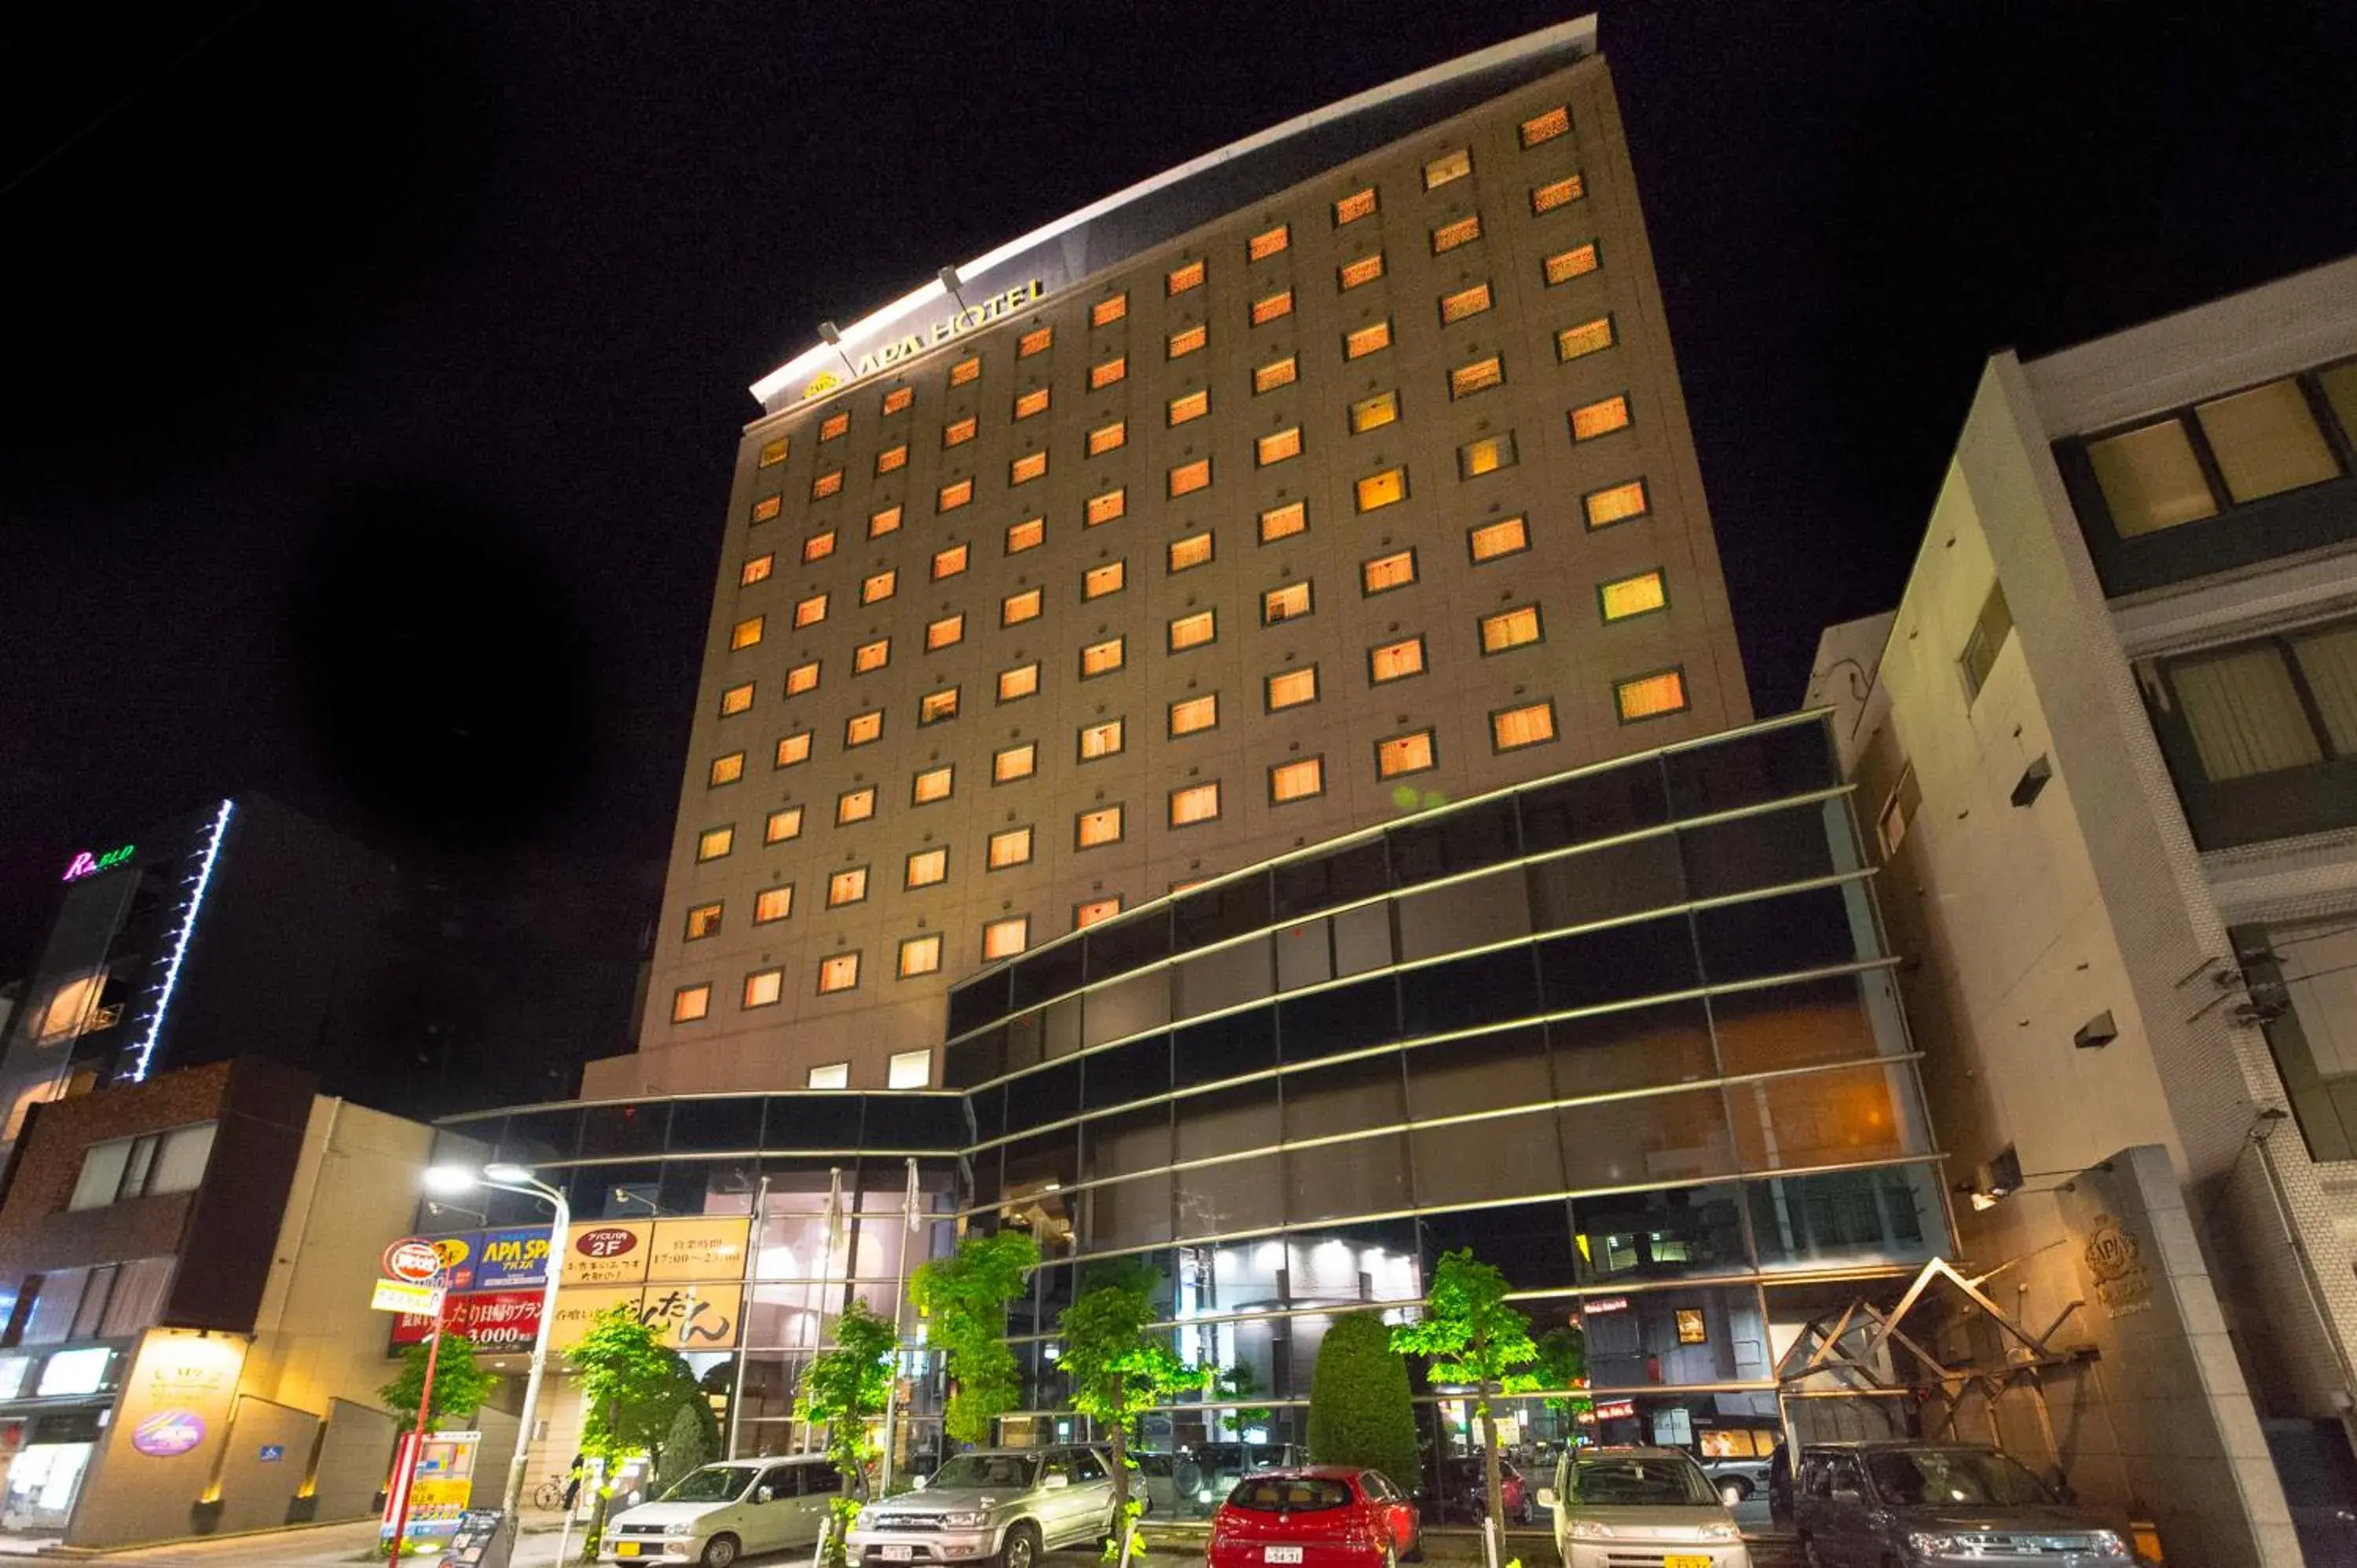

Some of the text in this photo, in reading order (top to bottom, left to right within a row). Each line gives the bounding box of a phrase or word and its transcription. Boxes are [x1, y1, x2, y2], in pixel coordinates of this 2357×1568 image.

[857, 278, 1046, 374] APA HOTEL
[482, 1240, 522, 1262] APA
[591, 1240, 621, 1256] 2F
